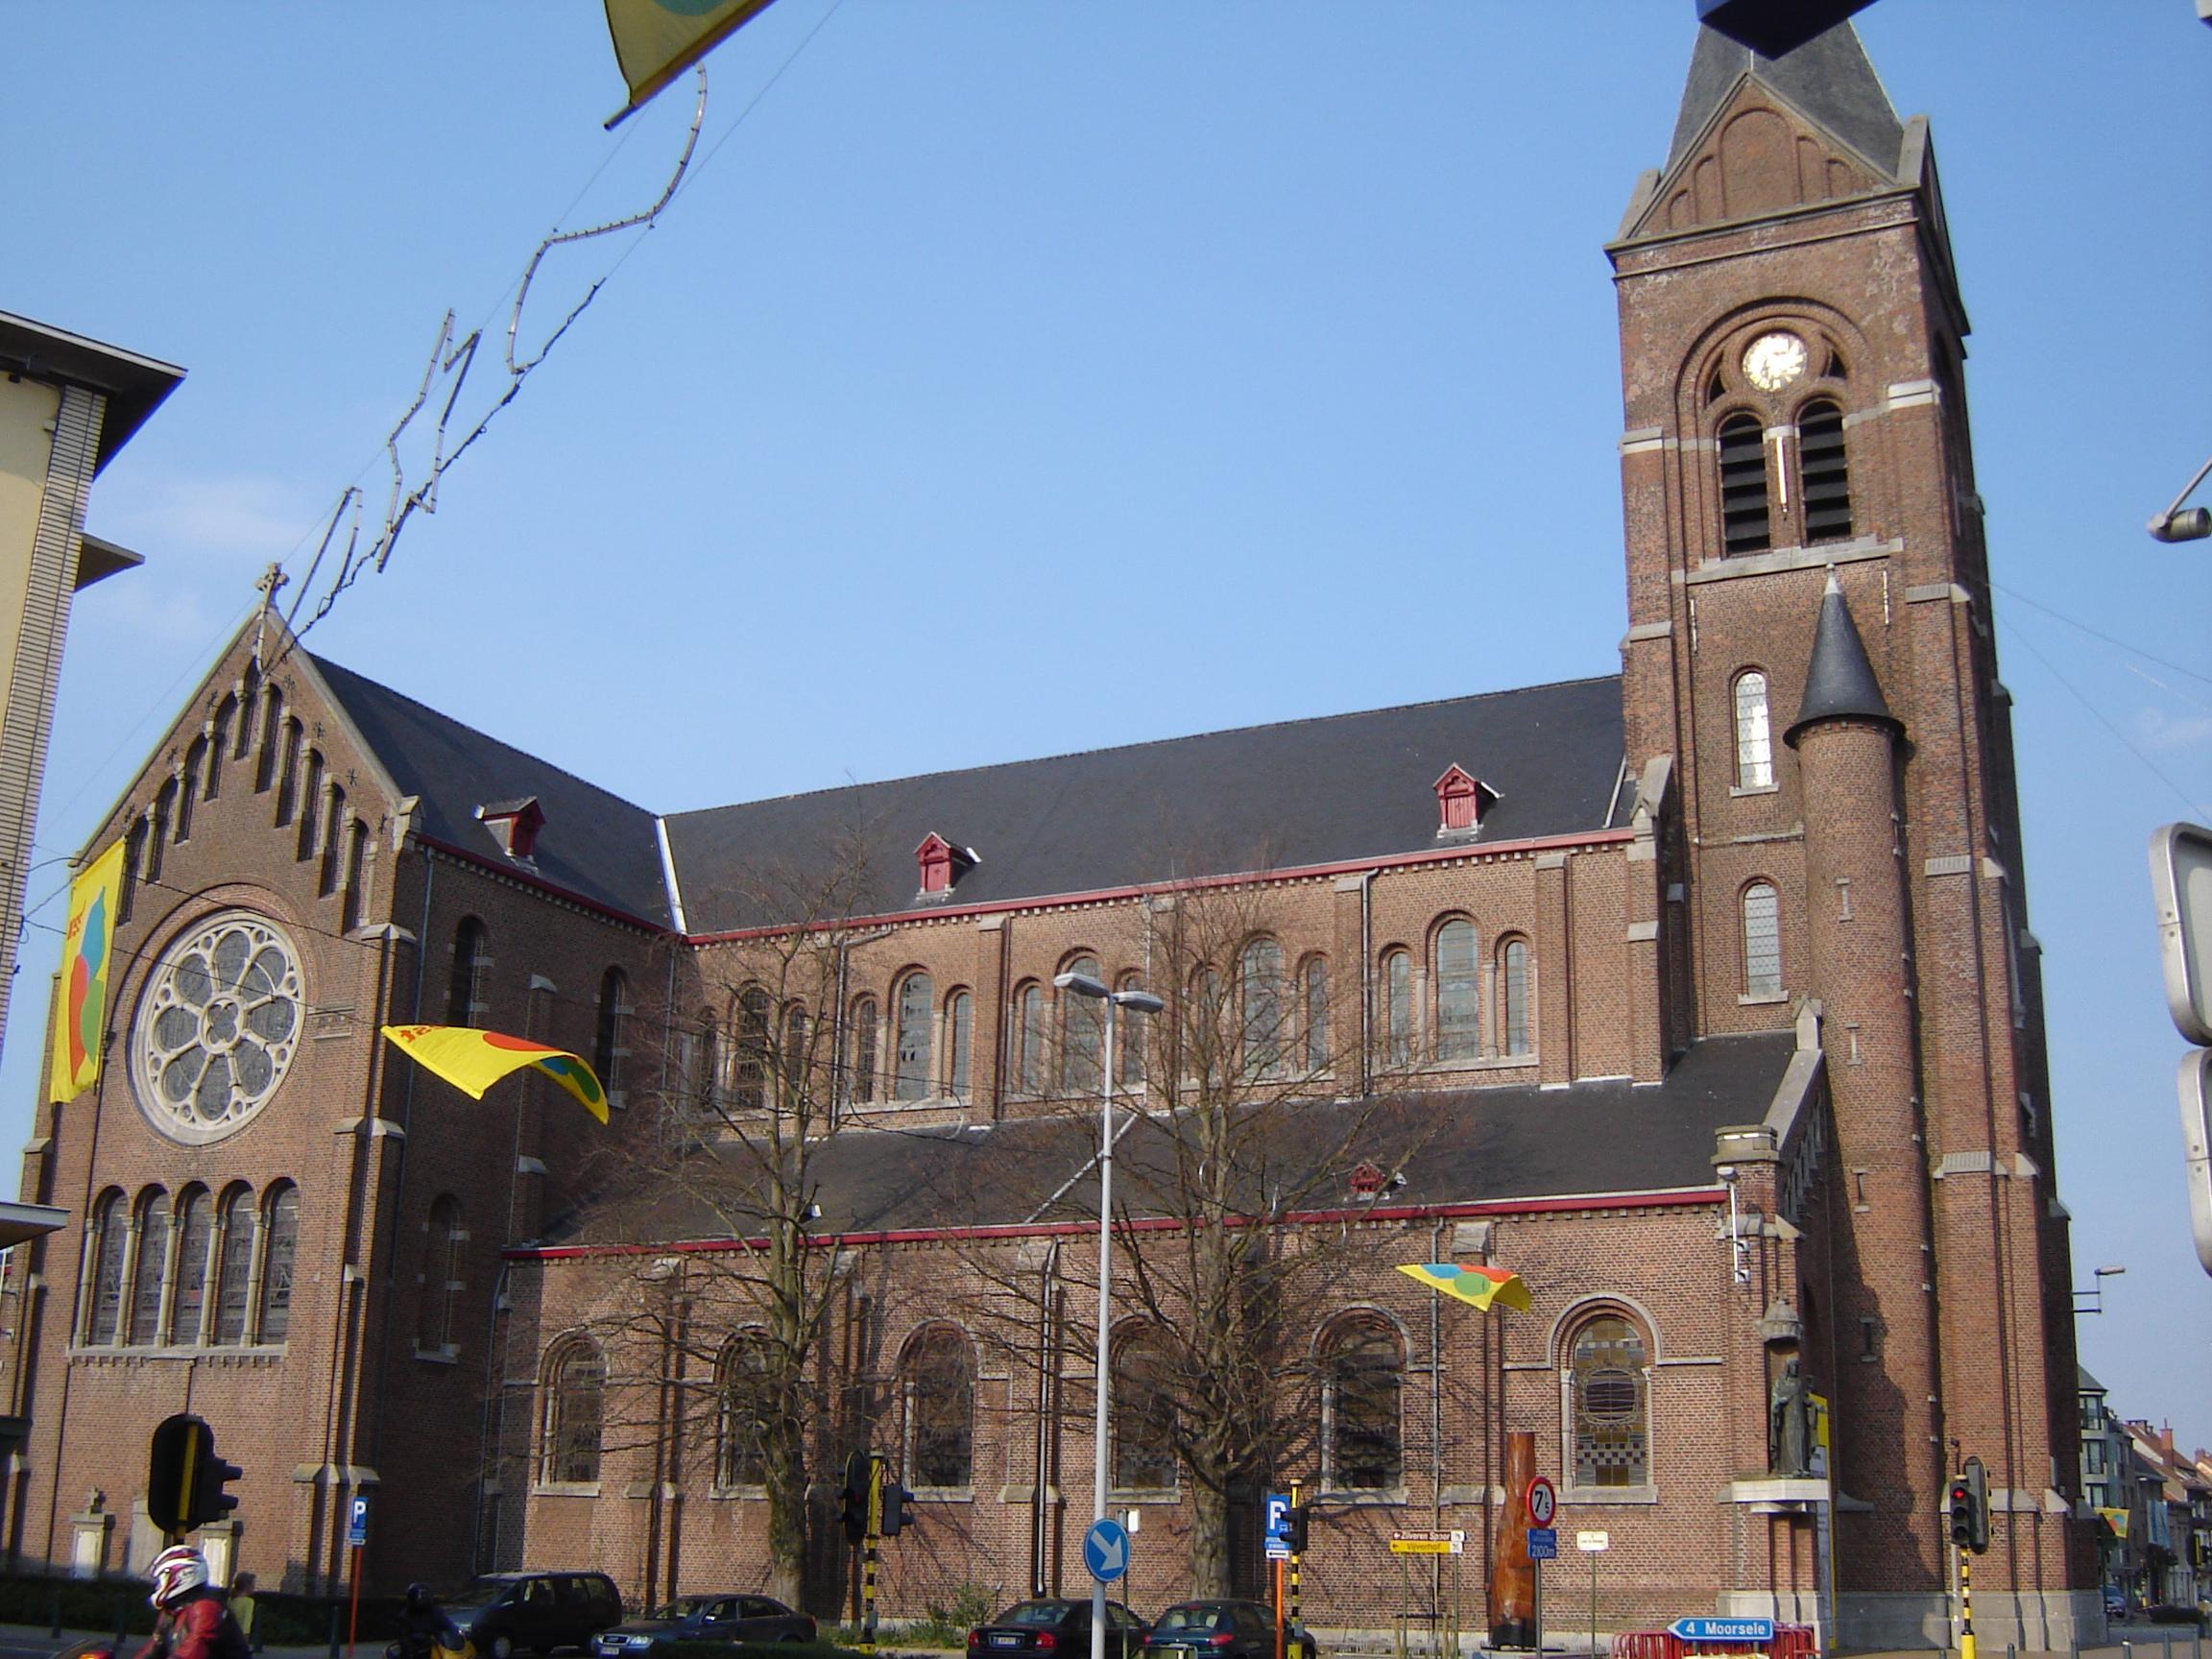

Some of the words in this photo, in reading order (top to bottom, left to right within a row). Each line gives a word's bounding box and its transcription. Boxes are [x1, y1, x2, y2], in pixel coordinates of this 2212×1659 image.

[353, 1501, 367, 1524] P
[1269, 1501, 1286, 1529] P
[1686, 1622, 1695, 1634] 4
[1705, 1622, 1766, 1635] Moorsele
